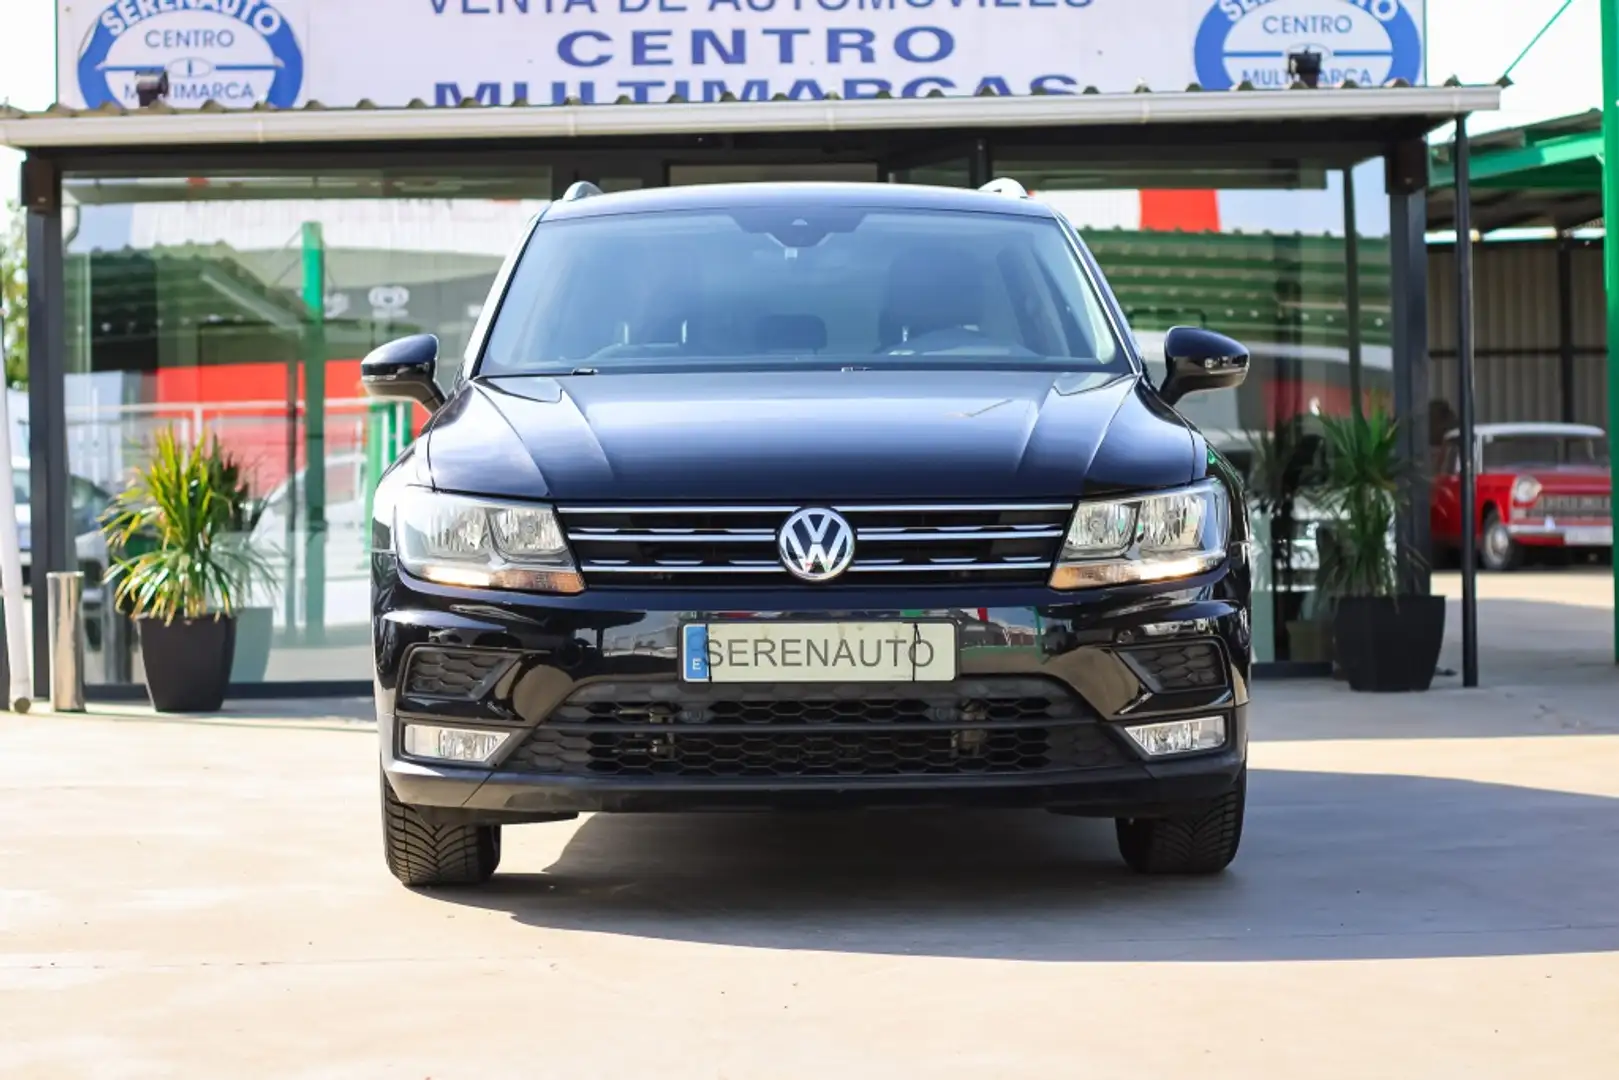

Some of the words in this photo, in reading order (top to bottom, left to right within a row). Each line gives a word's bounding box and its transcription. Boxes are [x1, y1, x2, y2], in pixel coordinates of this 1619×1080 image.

[1262, 15, 1353, 34] CENTRO
[144, 29, 235, 48] CENTRO
[557, 26, 956, 67] CENTRO
[1242, 68, 1372, 86] MULTARCA
[123, 81, 254, 100] MIMARCA
[692, 658, 701, 669] E
